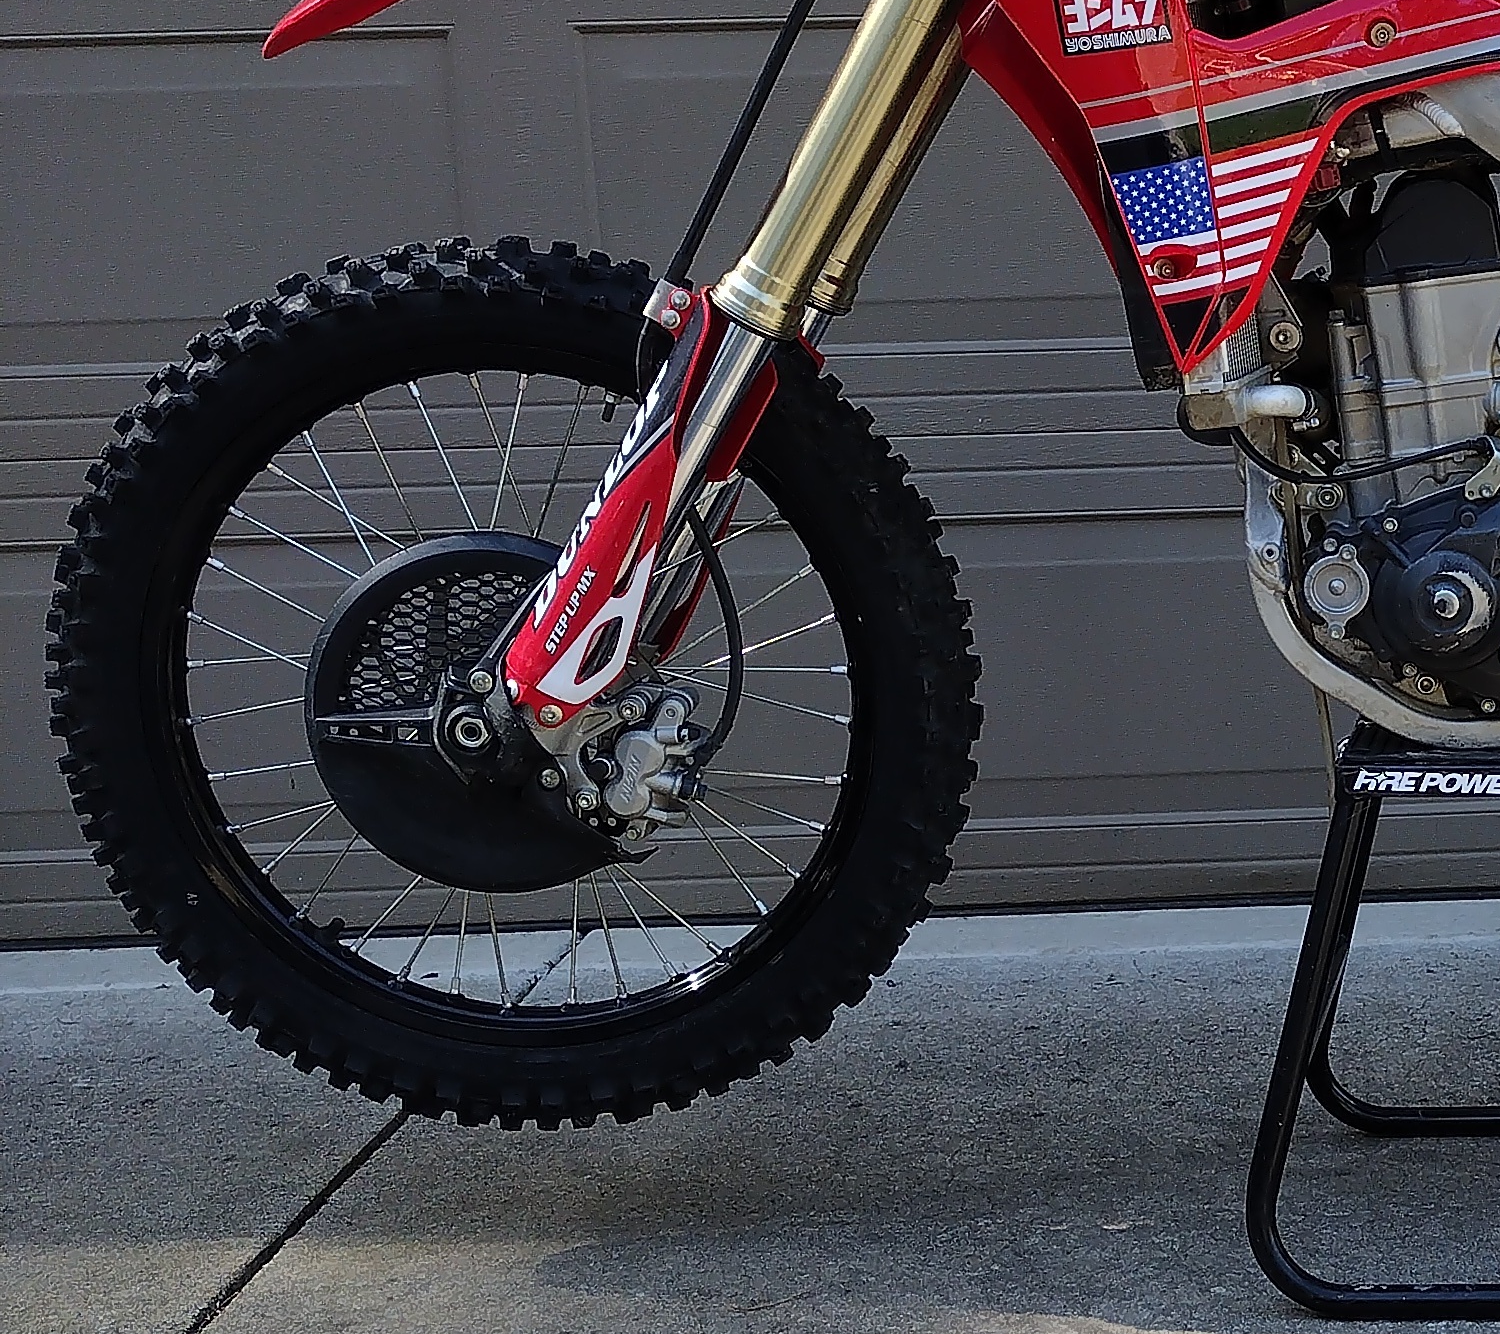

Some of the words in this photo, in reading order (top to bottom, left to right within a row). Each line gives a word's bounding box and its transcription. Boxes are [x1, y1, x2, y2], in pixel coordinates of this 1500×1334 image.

[1064, 25, 1172, 53] YOSHIMURA
[545, 612, 568, 655] STEP
[565, 590, 580, 617] UP
[576, 565, 597, 596] MX
